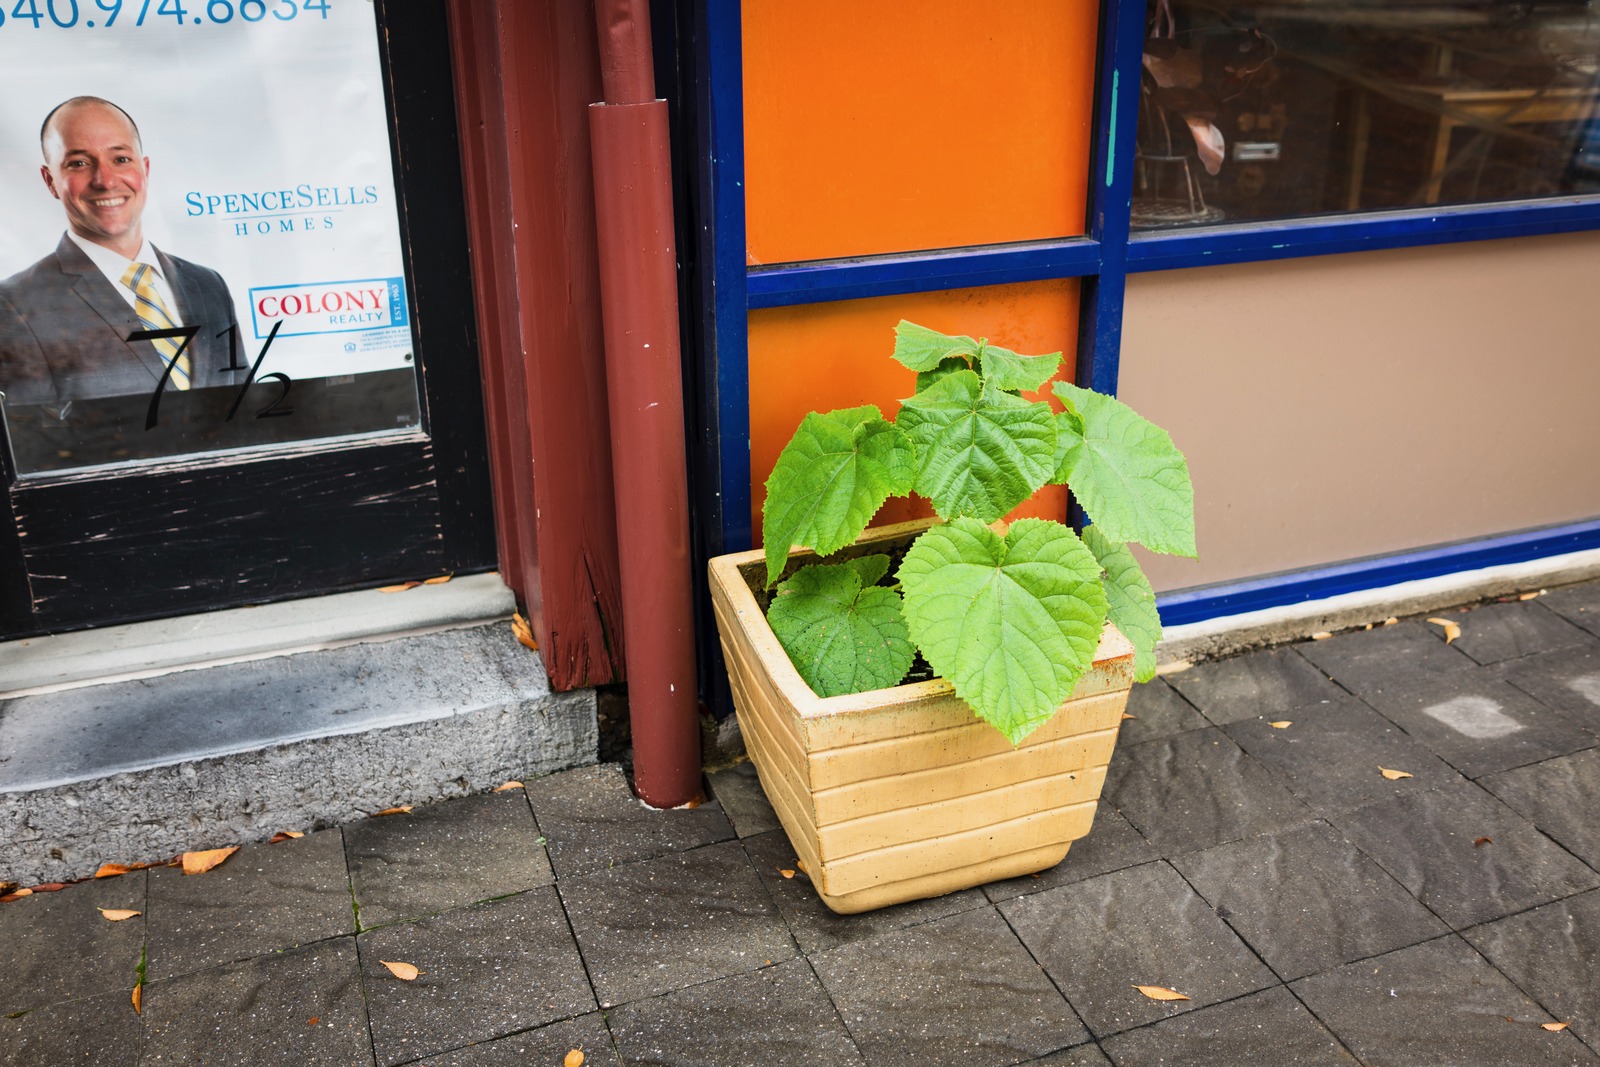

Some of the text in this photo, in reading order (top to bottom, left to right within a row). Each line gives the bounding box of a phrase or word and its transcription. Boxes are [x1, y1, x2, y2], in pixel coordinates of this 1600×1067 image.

[235, 216, 334, 236] HOMES
[258, 288, 384, 318] COLONY
[394, 303, 402, 321] EST.
[329, 311, 383, 325] REALTY
[126, 326, 200, 431] 7
